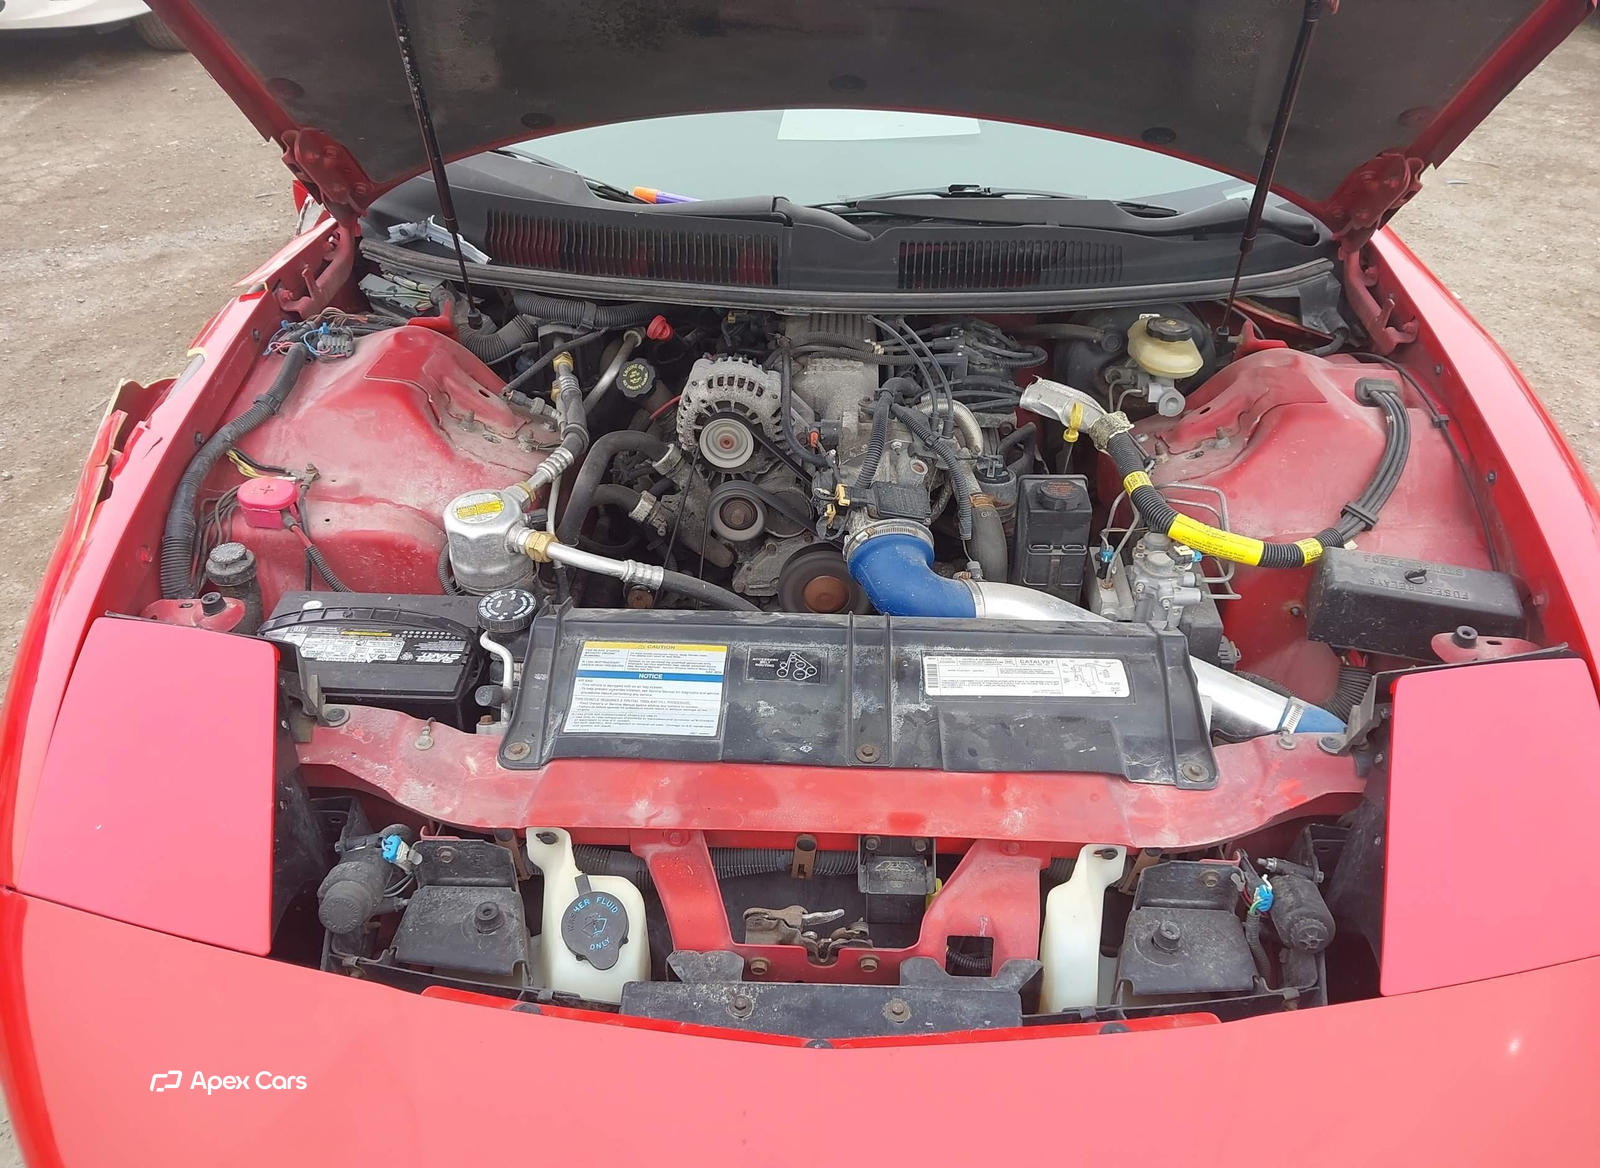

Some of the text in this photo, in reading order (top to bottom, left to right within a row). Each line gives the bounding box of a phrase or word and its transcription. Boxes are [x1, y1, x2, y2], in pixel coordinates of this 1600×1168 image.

[1306, 549, 1322, 559] FUEL
[1363, 554, 1463, 576] FUSES RELAYS
[1368, 577, 1469, 599] FUSES RELAYS
[567, 896, 619, 932] WASHER FLUID
[590, 937, 610, 951] ONLY
